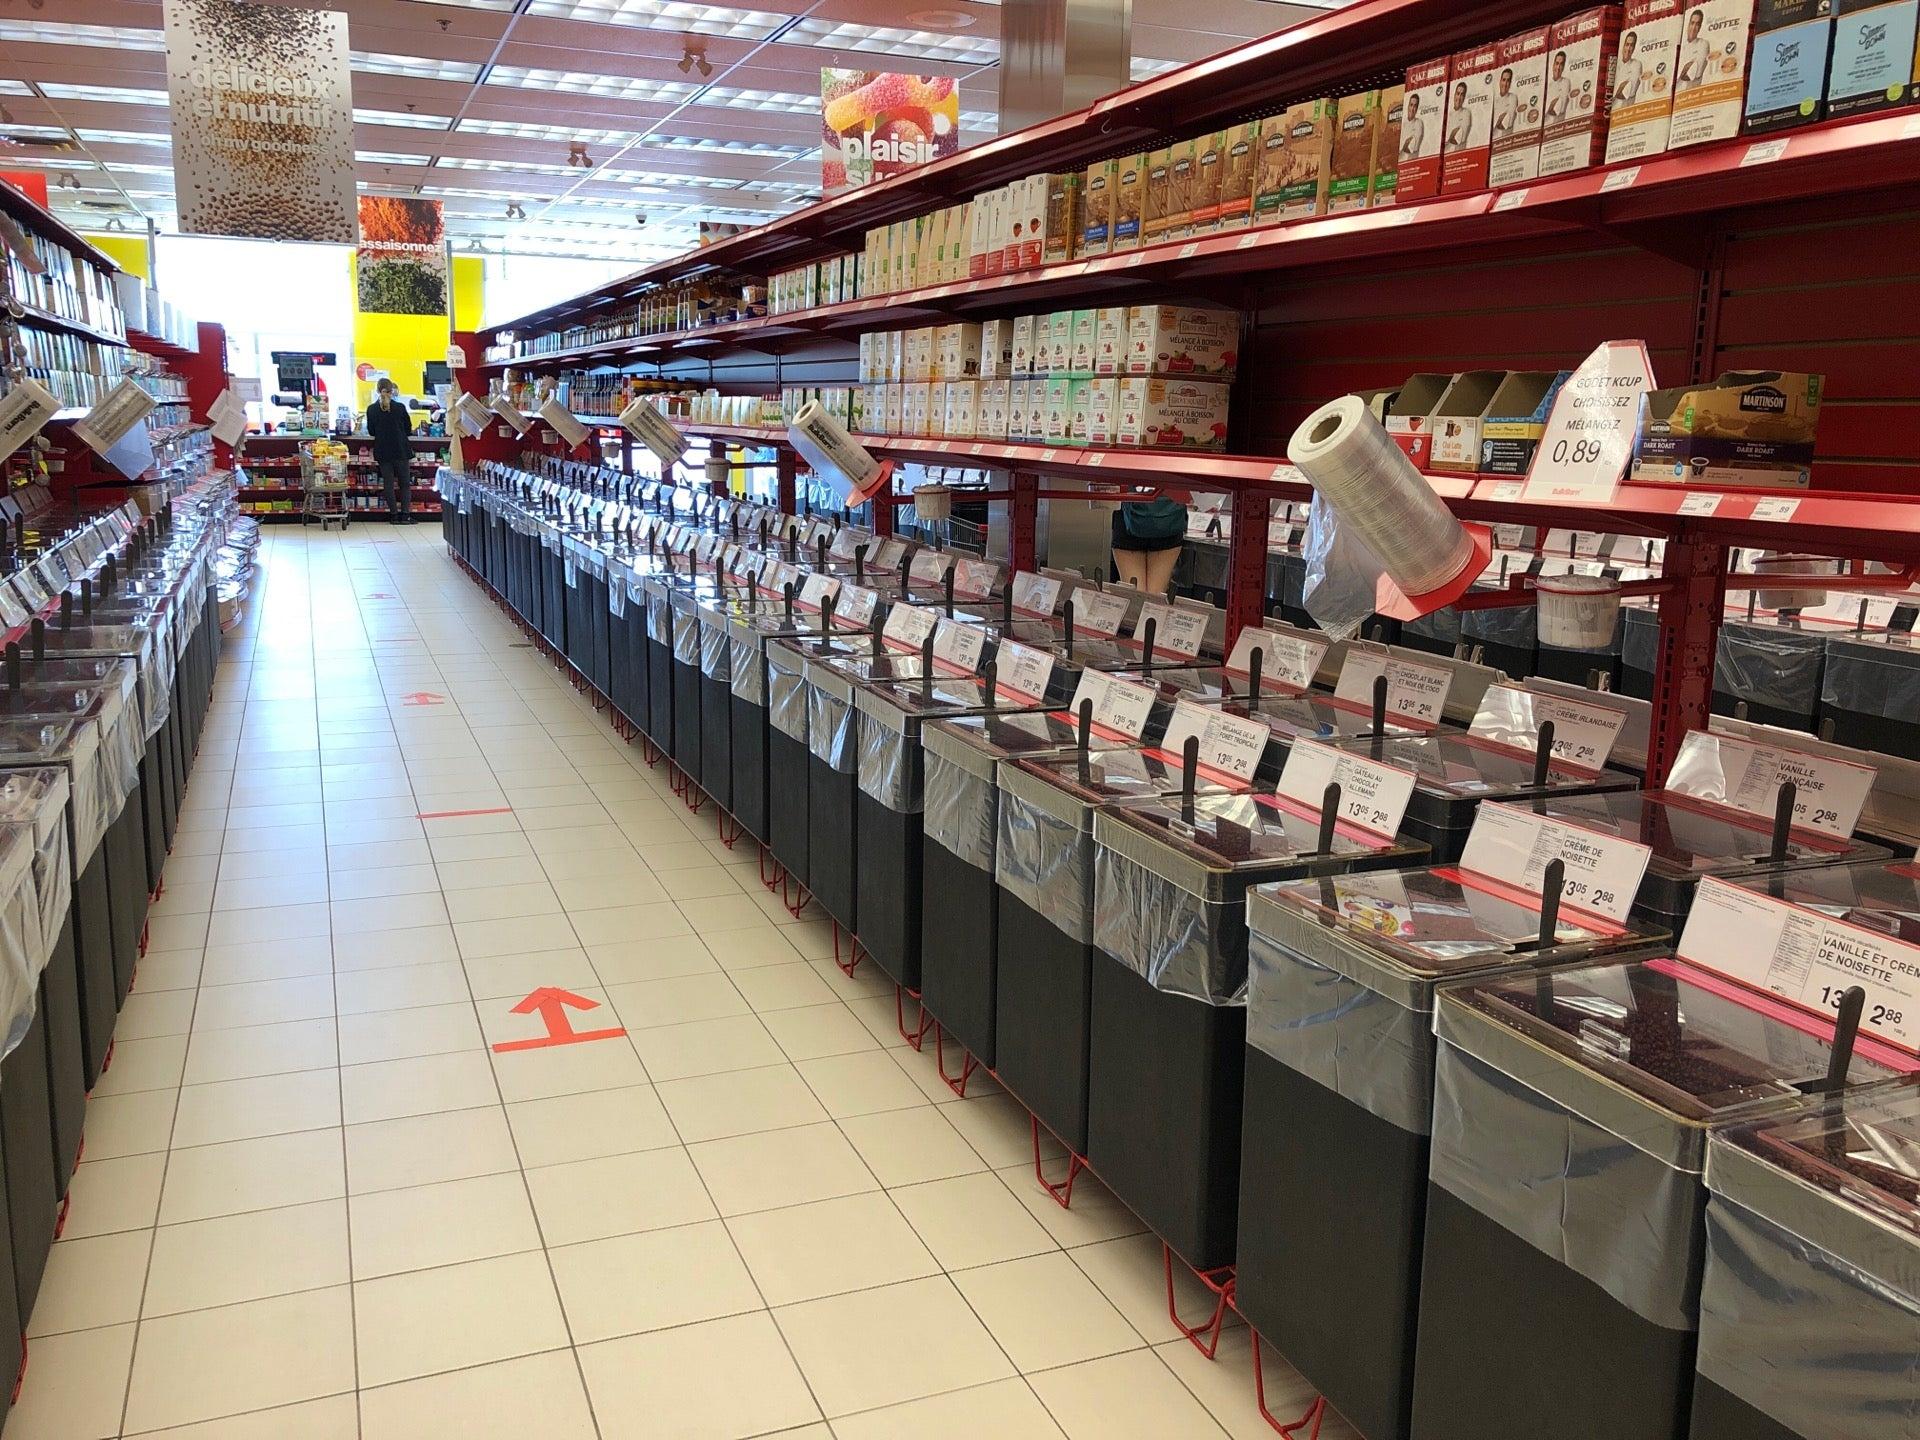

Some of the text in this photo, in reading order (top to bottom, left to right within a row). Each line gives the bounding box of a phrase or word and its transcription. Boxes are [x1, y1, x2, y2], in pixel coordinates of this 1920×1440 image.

[1628, 3, 1648, 20] CAKE
[1557, 18, 1599, 40] CAKE BOSS
[1708, 18, 1740, 32] COFFEE
[1503, 36, 1545, 58] CAKE BOSS
[1641, 40, 1669, 53] COFFEE
[1457, 53, 1495, 71] CAKE BOSS
[1569, 58, 1594, 72] COFFEE
[190, 62, 331, 99] délicieux
[1410, 69, 1427, 84] CAKE
[1516, 75, 1540, 88] COFFEE
[192, 91, 332, 128] et nutritif
[250, 138, 329, 155] goodness
[842, 131, 939, 166] plaisir
[359, 239, 441, 253] assaisonnez
[1612, 376, 1642, 387] KCUP
[1742, 394, 1784, 409] MARTINSON
[1565, 419, 1621, 431] MÉLANGEZ
[1552, 439, 1601, 467] 0,89
[1579, 715, 1618, 730] IRLANDAISE
[1780, 762, 1816, 778] VANILLE
[1351, 775, 1379, 791] CHOCOLAT
[1775, 772, 1825, 791] FRANÇAISE
[1564, 839, 1604, 858] CRÈME DE
[1559, 850, 1598, 868] NOISETTE
[1823, 935, 1869, 960] VANILLE
[1871, 953, 1888, 966] ET
[1818, 948, 1893, 983] DE NOISETTE
